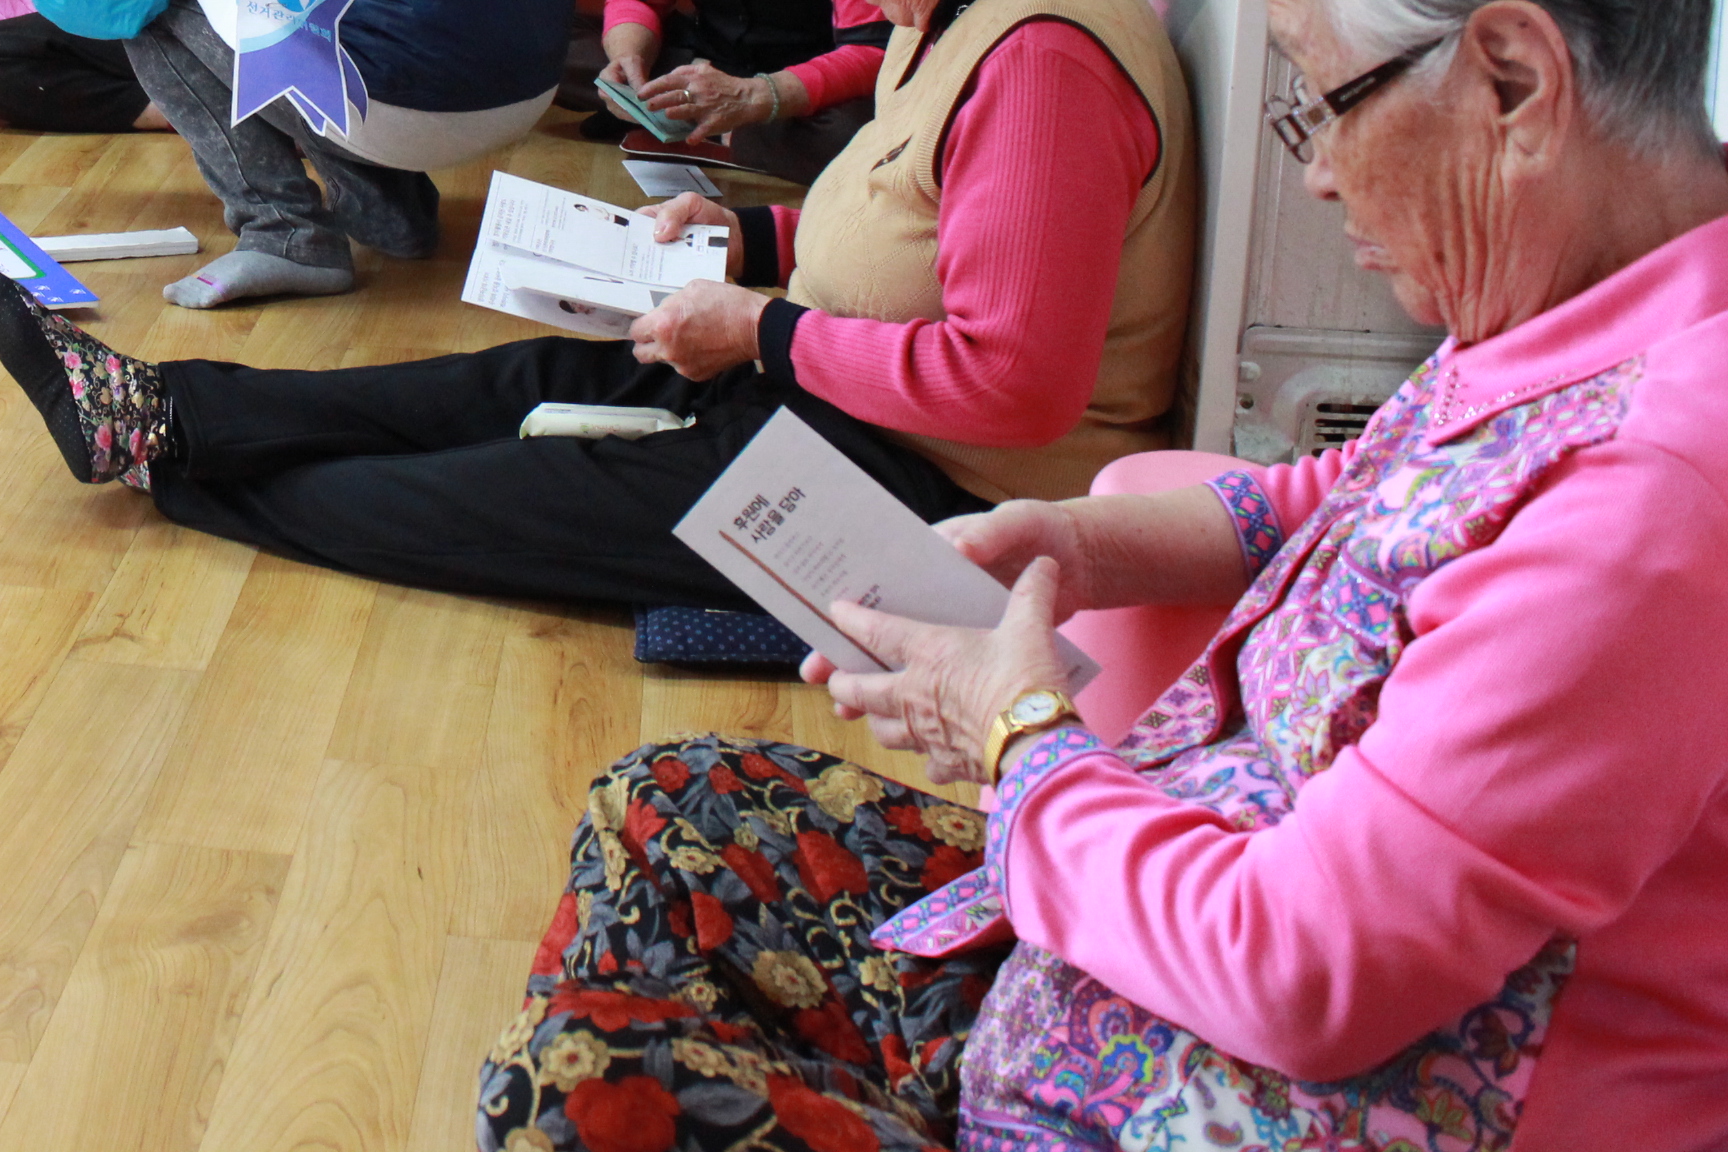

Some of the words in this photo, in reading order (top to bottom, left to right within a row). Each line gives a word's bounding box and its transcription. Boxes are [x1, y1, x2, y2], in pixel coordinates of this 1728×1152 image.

[733, 493, 771, 531] 후원에
[750, 509, 786, 544] 사랑을
[778, 486, 807, 513] 담아
